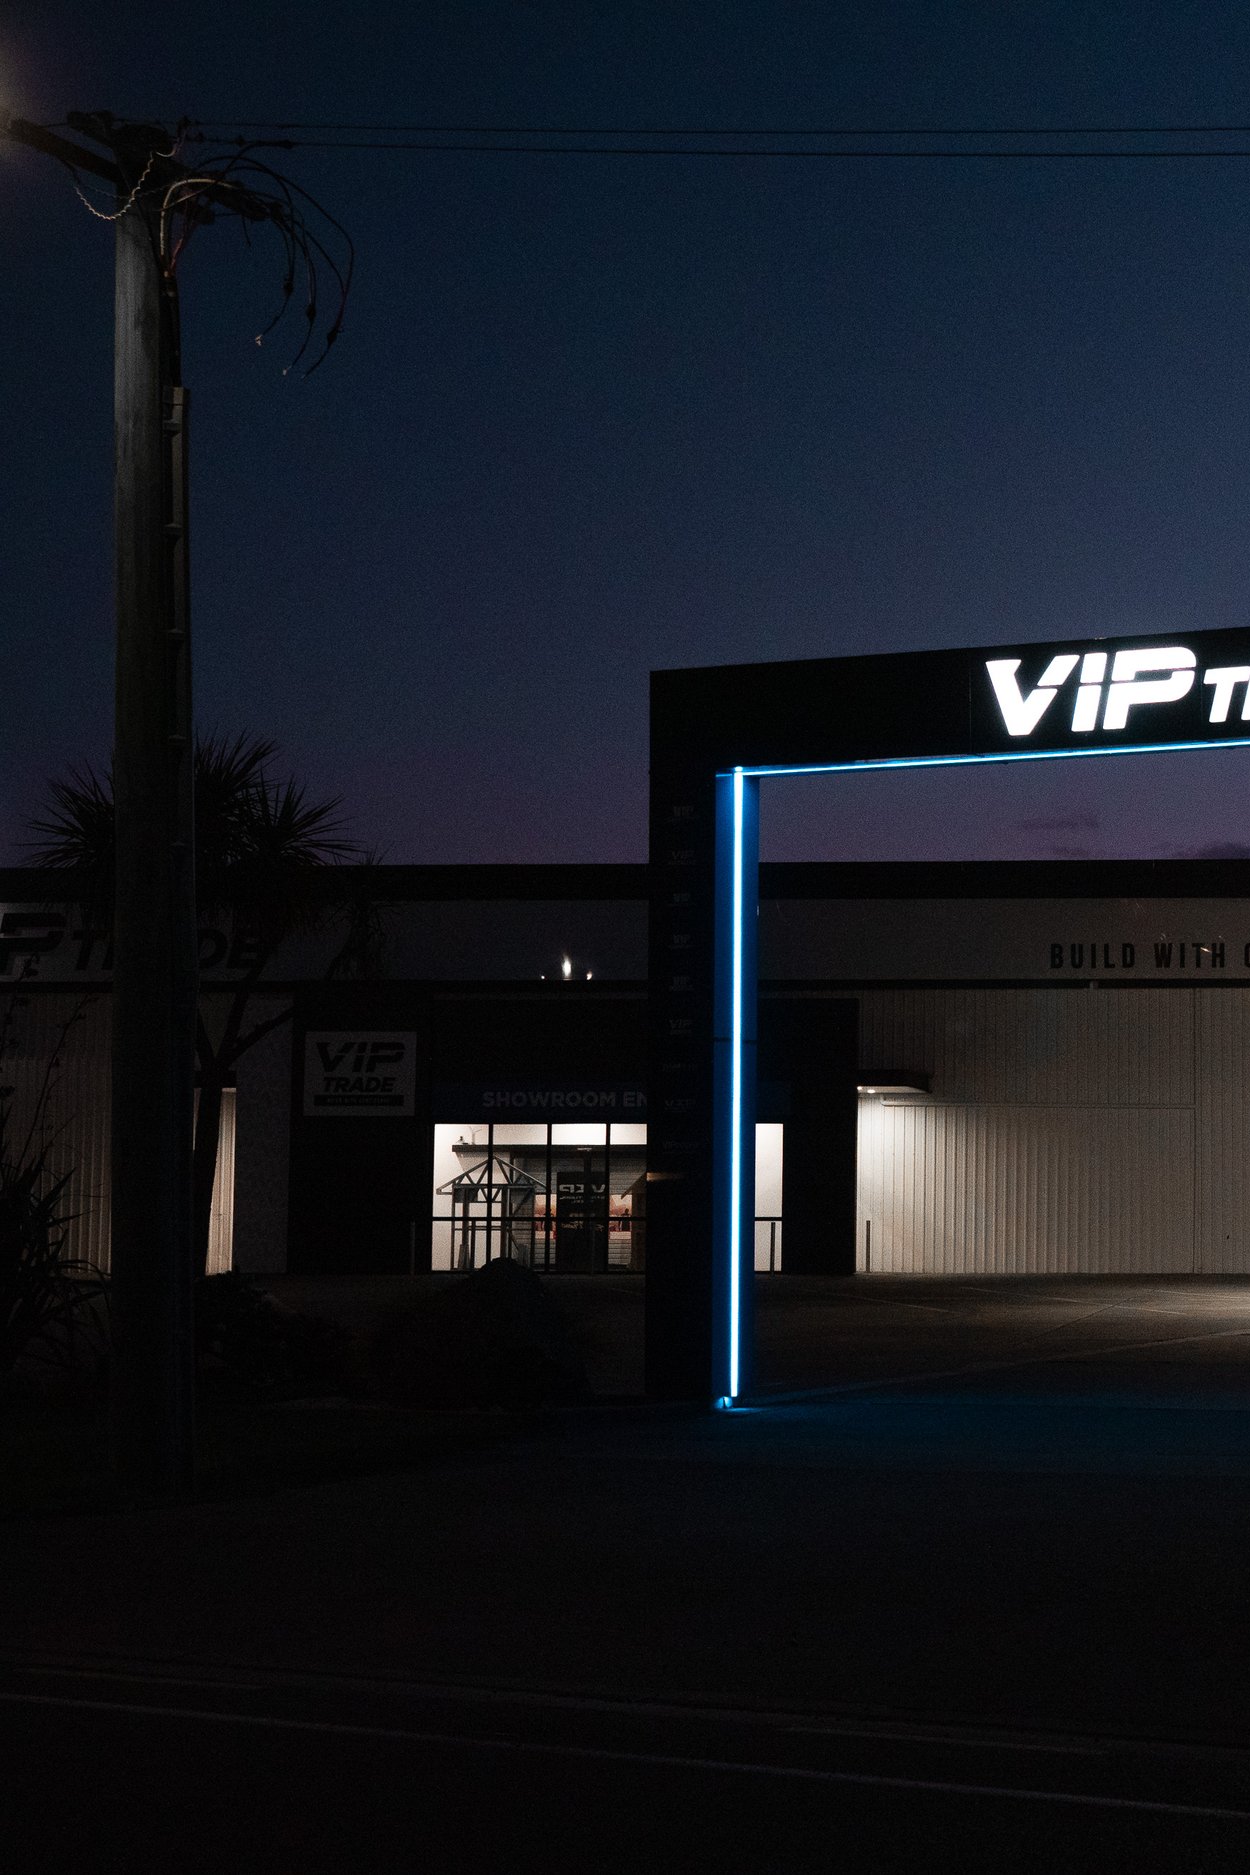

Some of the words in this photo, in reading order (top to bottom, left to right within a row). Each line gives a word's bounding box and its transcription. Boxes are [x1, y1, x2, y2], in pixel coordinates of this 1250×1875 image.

[985, 646, 1196, 736] VIP
[1050, 943, 1136, 969] BUILD
[1153, 943, 1226, 969] WITH
[316, 1042, 406, 1072] VIP
[323, 1077, 396, 1093] TRADE
[482, 1090, 616, 1108] SHOWROOM
